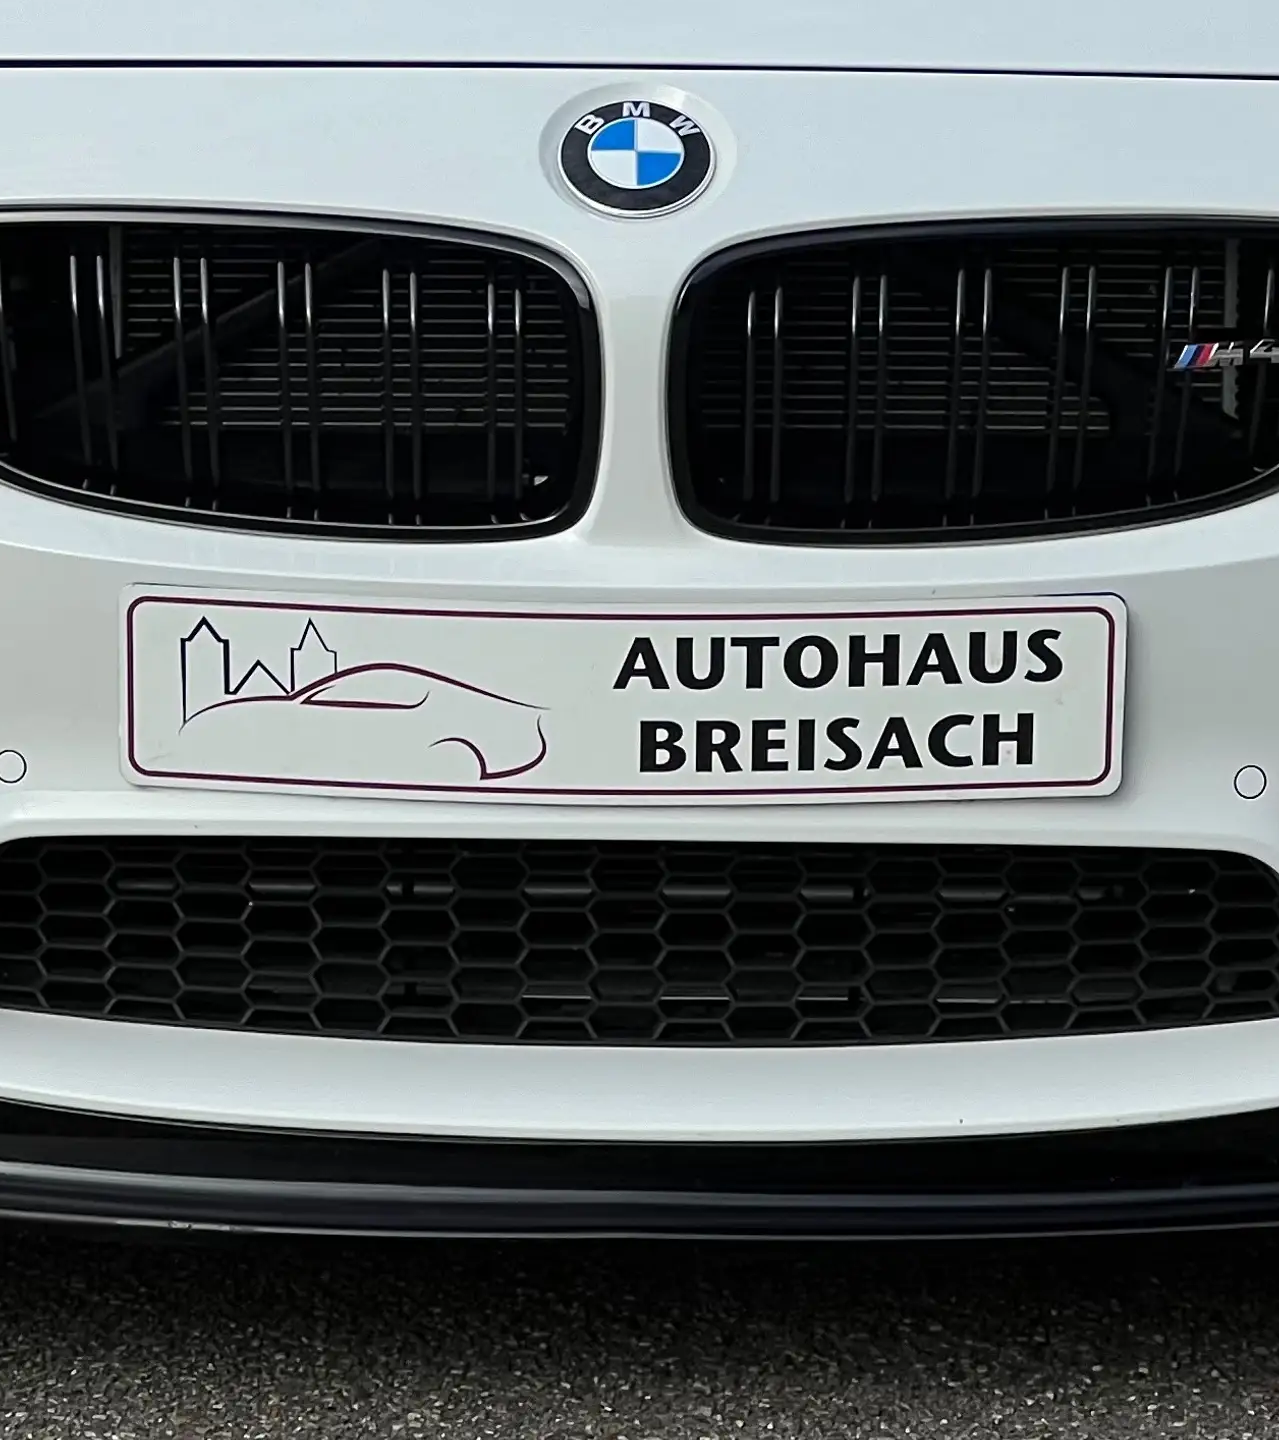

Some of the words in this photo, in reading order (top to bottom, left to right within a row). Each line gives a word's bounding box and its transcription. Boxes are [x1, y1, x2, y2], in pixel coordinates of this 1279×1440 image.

[574, 102, 701, 137] BMW
[612, 629, 1064, 690] AUTOHAUS
[639, 712, 1035, 773] BREISACH
